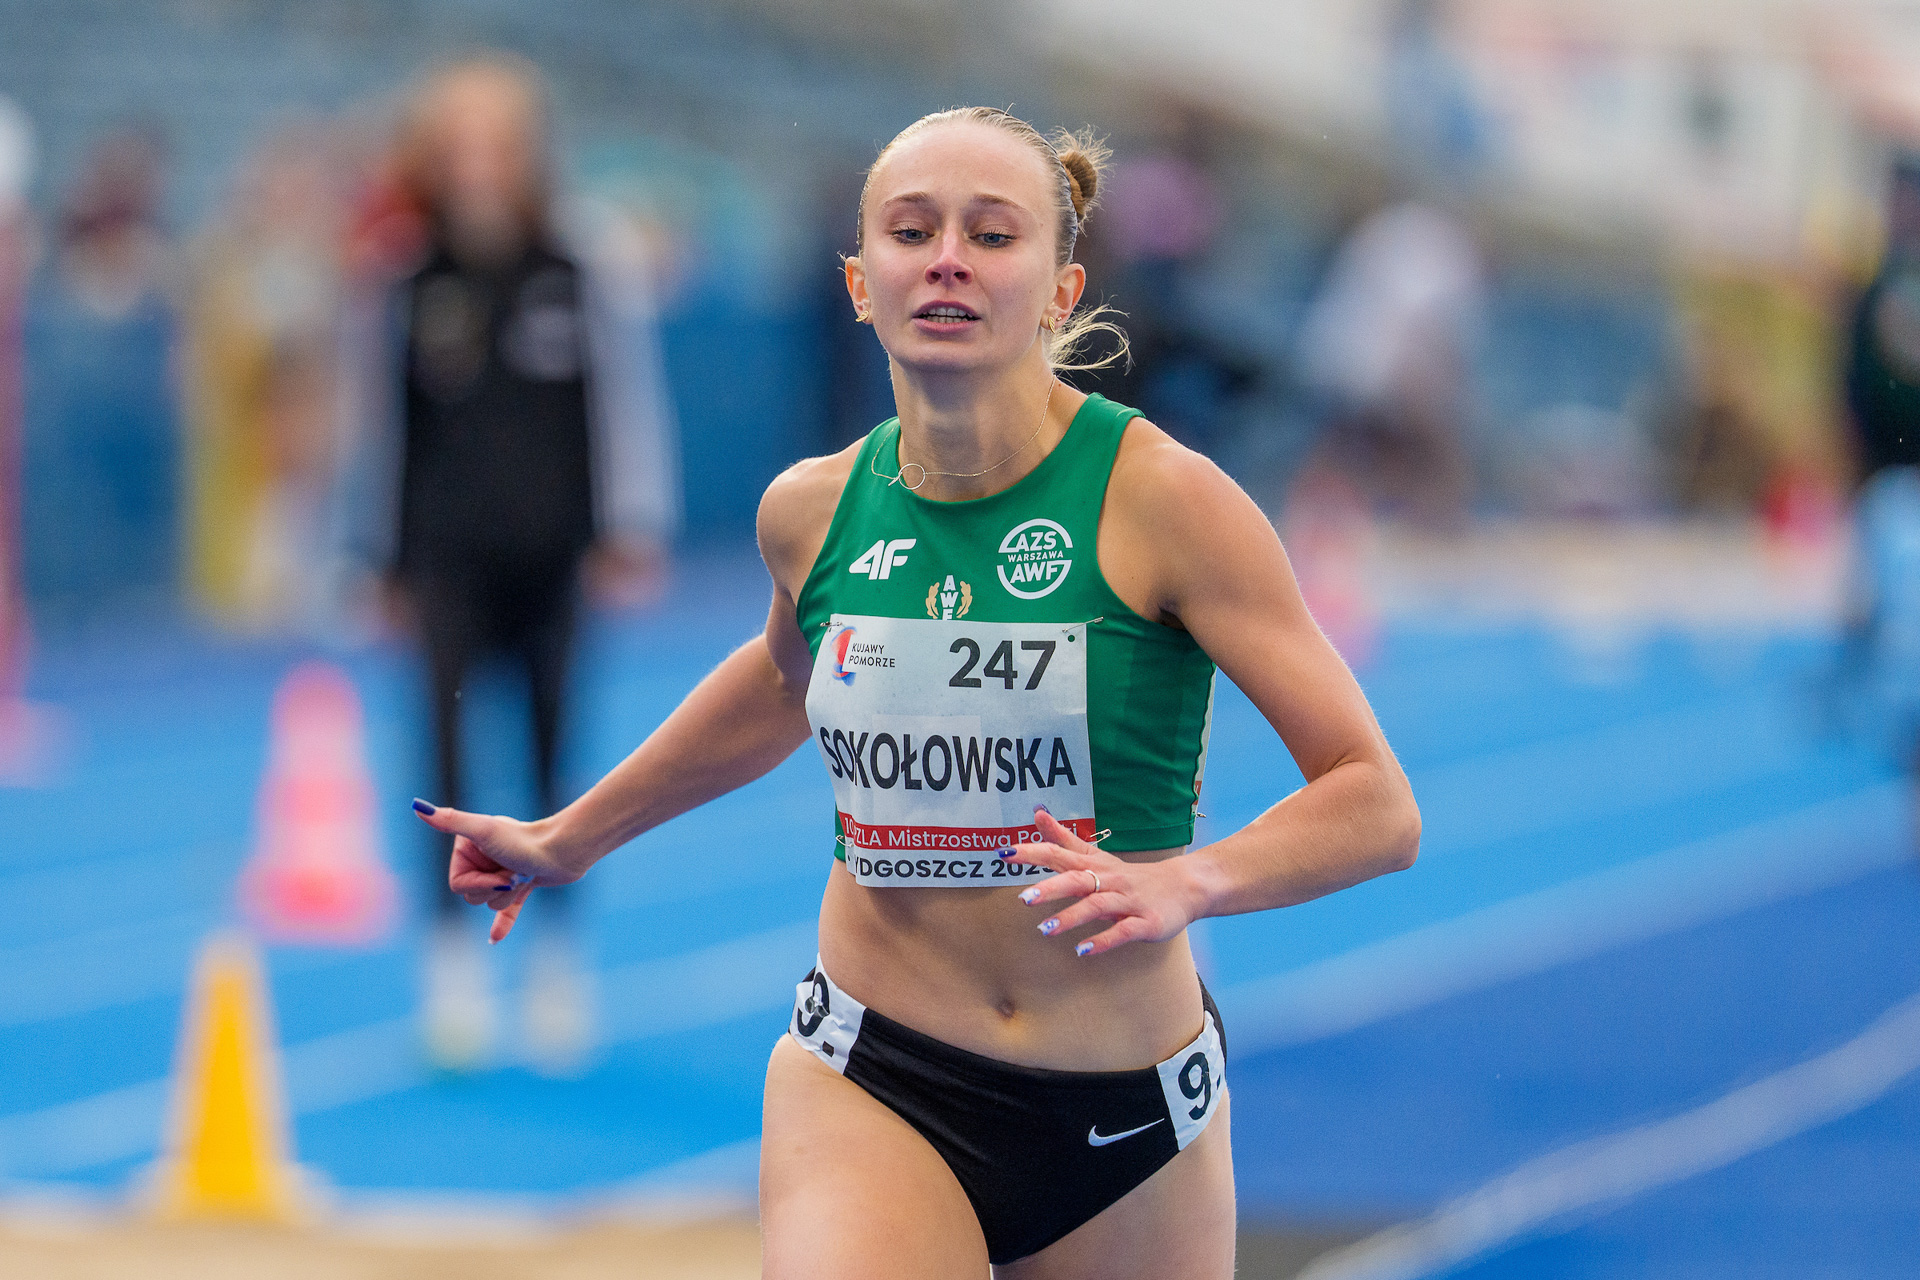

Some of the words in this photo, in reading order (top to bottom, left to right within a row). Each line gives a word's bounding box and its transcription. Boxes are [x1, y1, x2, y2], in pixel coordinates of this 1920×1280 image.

[1015, 531, 1057, 552] AZS
[849, 538, 917, 580] 4F
[1007, 550, 1064, 563] WARSZAWA
[1010, 560, 1059, 584] AWF
[852, 643, 885, 655] KUJAWY
[848, 655, 896, 668] POMORZE
[949, 637, 1056, 690] 247
[819, 726, 1078, 793] SOKOŁOWSKA
[888, 829, 1011, 848] Mistrzostwa
[1017, 822, 1078, 845] Poi
